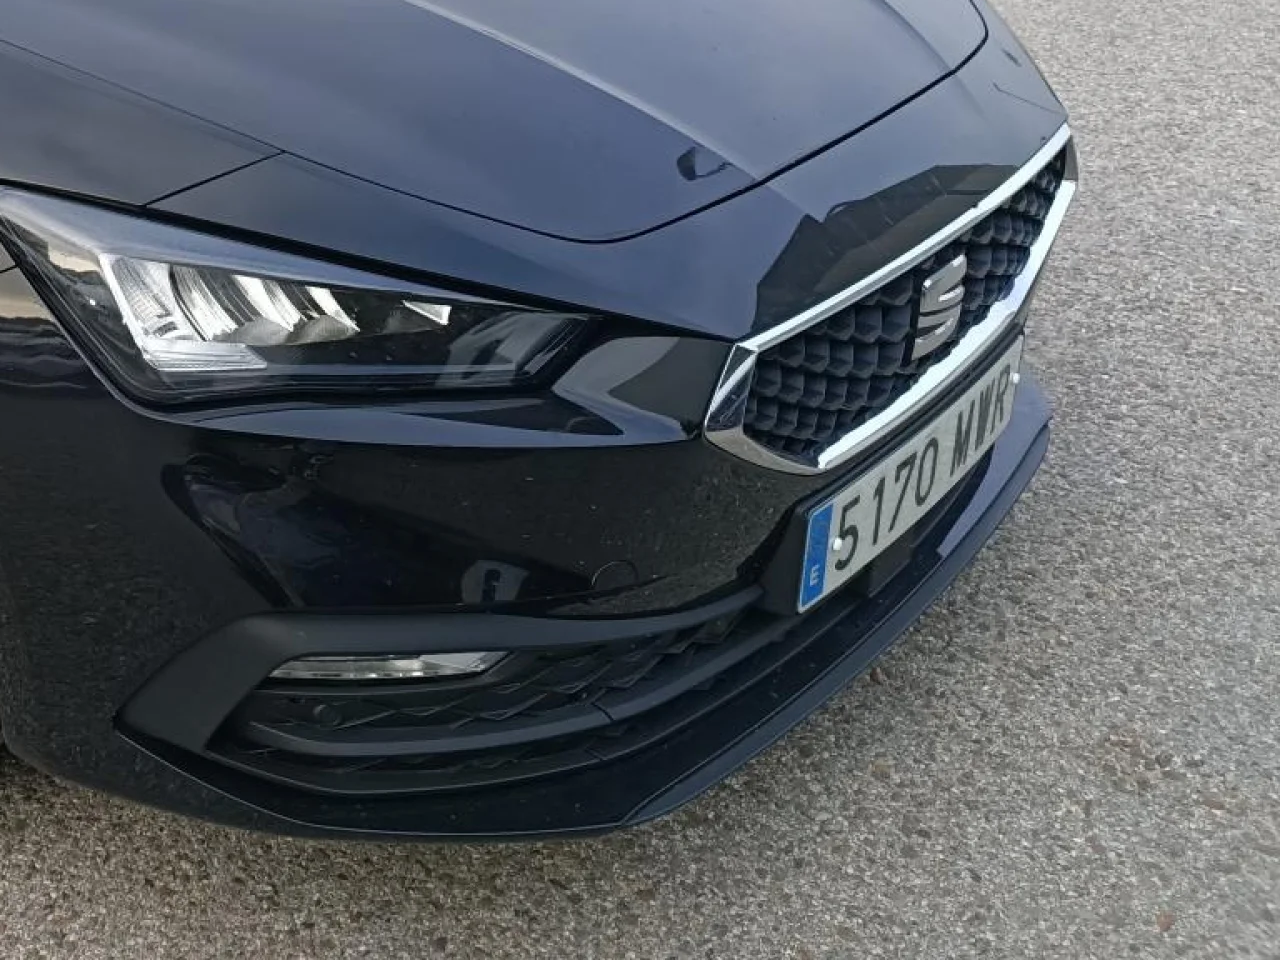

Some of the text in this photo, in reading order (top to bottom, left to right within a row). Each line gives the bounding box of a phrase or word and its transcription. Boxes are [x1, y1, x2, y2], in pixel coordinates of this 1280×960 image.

[835, 364, 1011, 571] 5170 MWR
[809, 565, 820, 586] E
